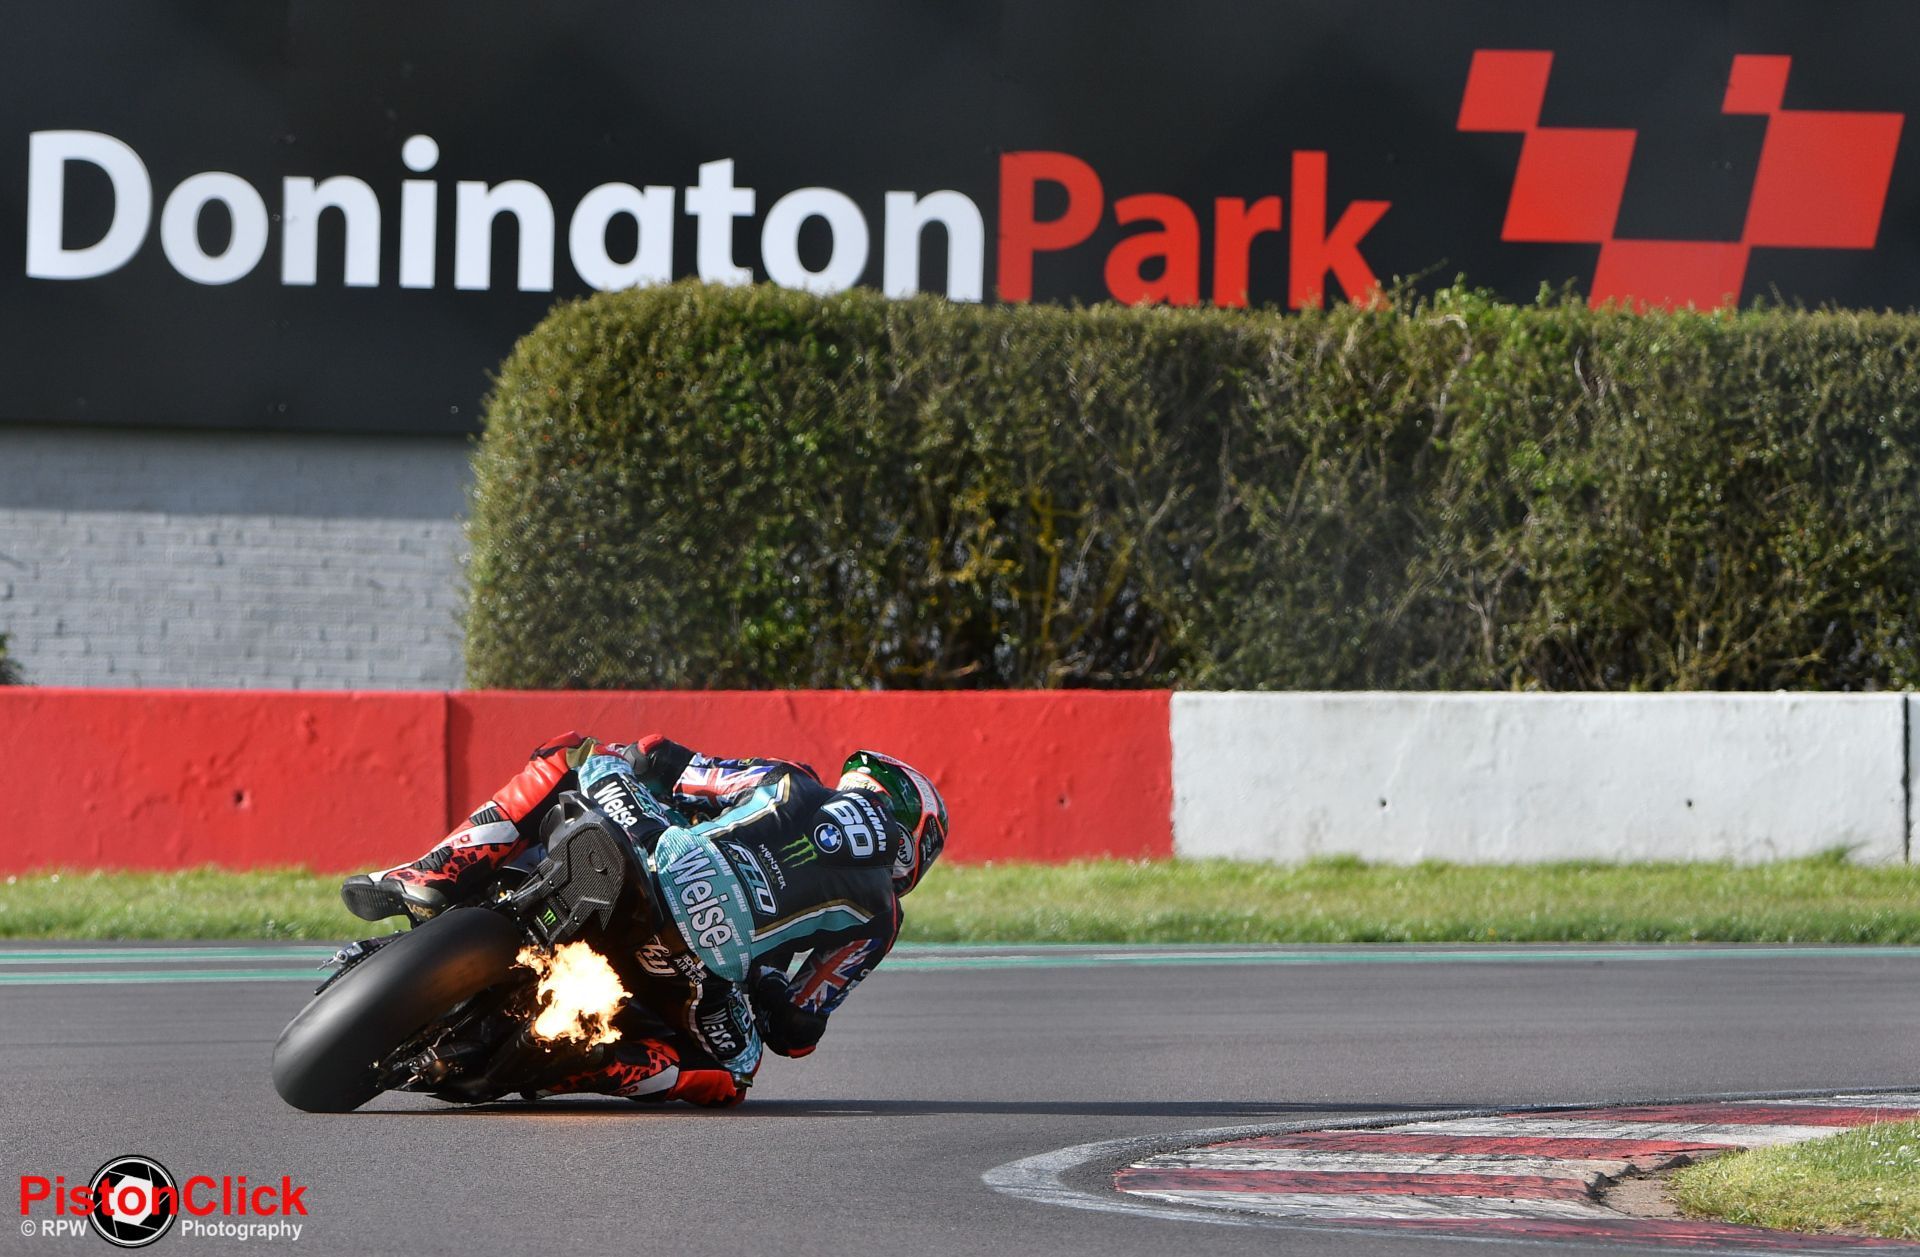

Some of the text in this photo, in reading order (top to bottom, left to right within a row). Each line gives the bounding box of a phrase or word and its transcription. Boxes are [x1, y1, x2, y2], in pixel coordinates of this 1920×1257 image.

[594, 781, 638, 828] Weise
[821, 800, 874, 858] 60
[759, 843, 786, 890] MONSTER
[667, 846, 732, 948] Weise
[674, 958, 702, 985] AIR BAG
